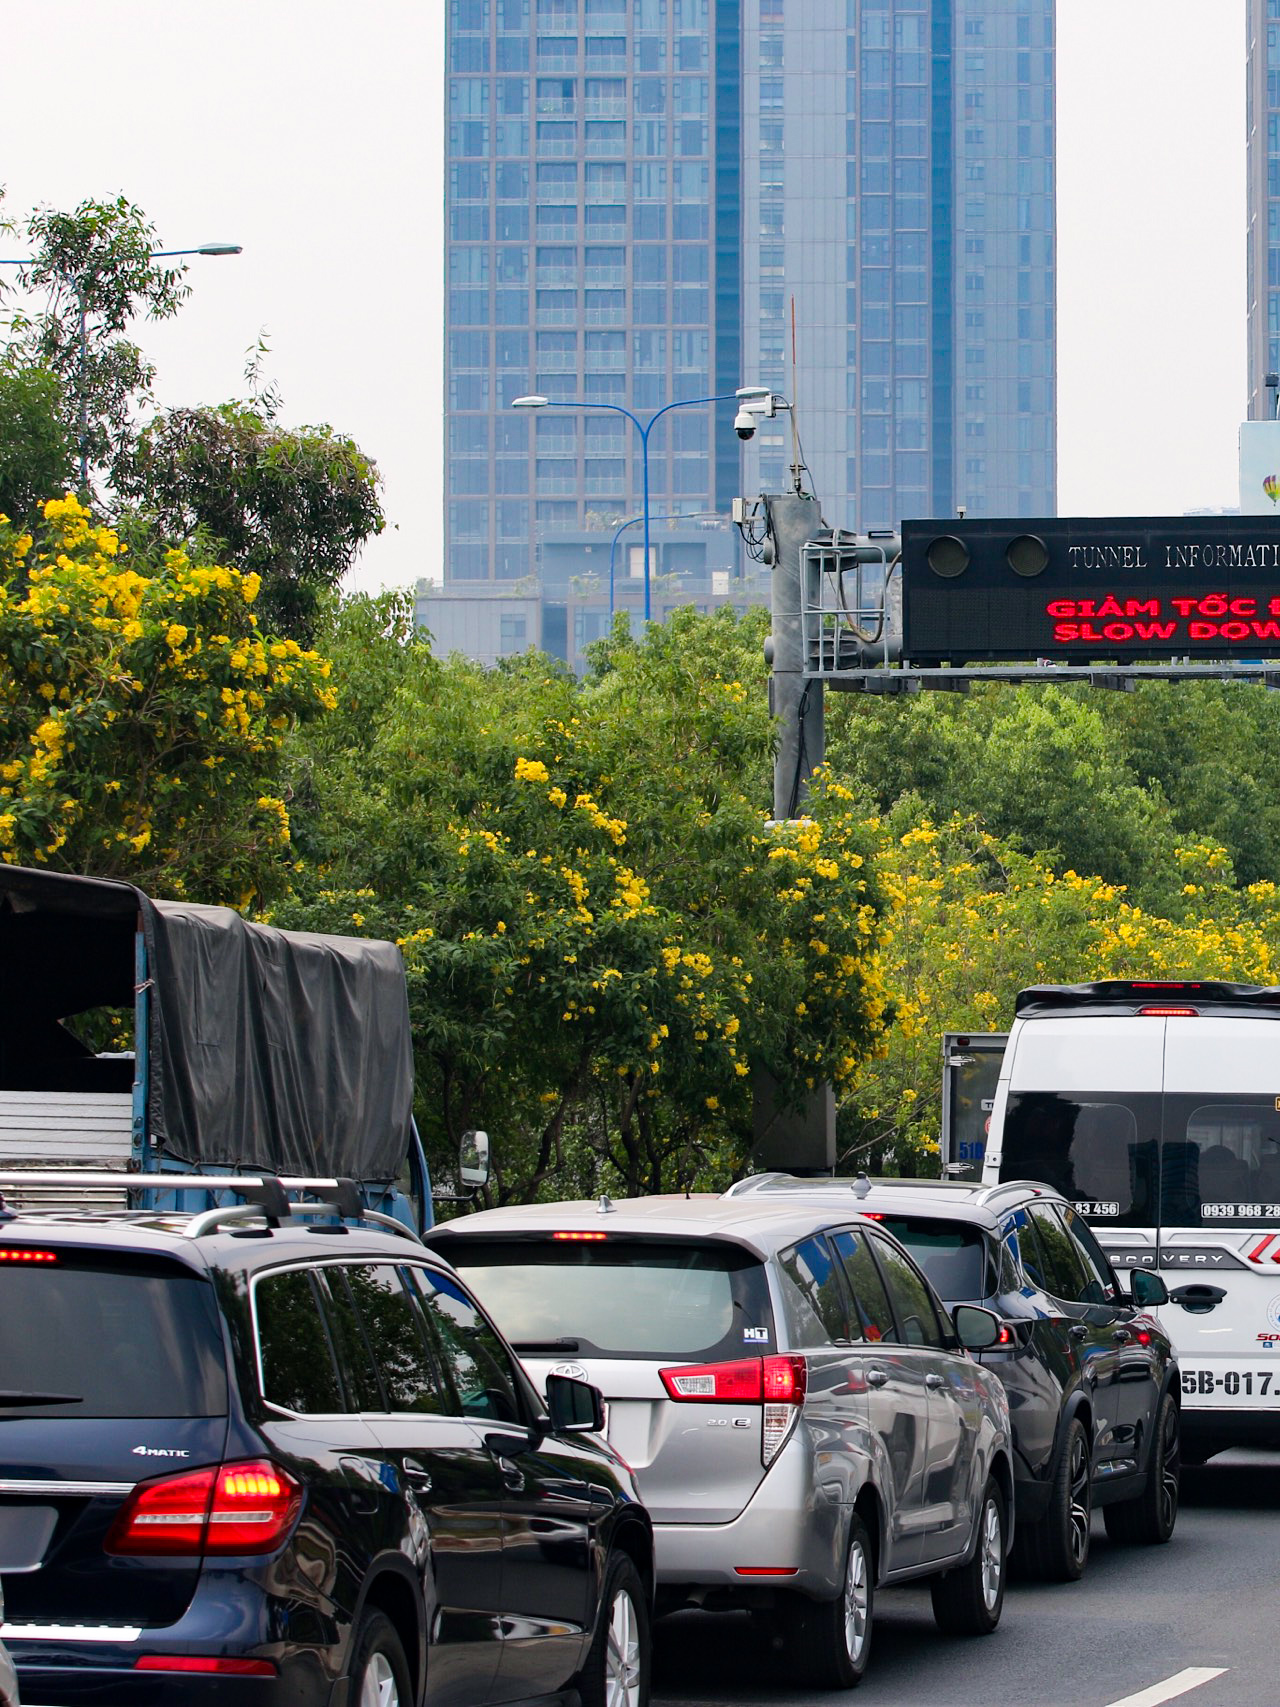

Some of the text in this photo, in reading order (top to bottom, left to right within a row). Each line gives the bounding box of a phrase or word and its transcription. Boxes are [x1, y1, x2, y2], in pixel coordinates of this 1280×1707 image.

[1068, 546, 1148, 568] TUNNEL
[1046, 593, 1159, 617] GIẢM
[1171, 593, 1257, 617] TỐC
[1053, 622, 1178, 641] SLOW
[1094, 1203, 1117, 1215] 456
[1204, 1205, 1235, 1217] 0939
[1238, 1205, 1262, 1217] 968
[132, 1445, 190, 1457] 4MATIC
